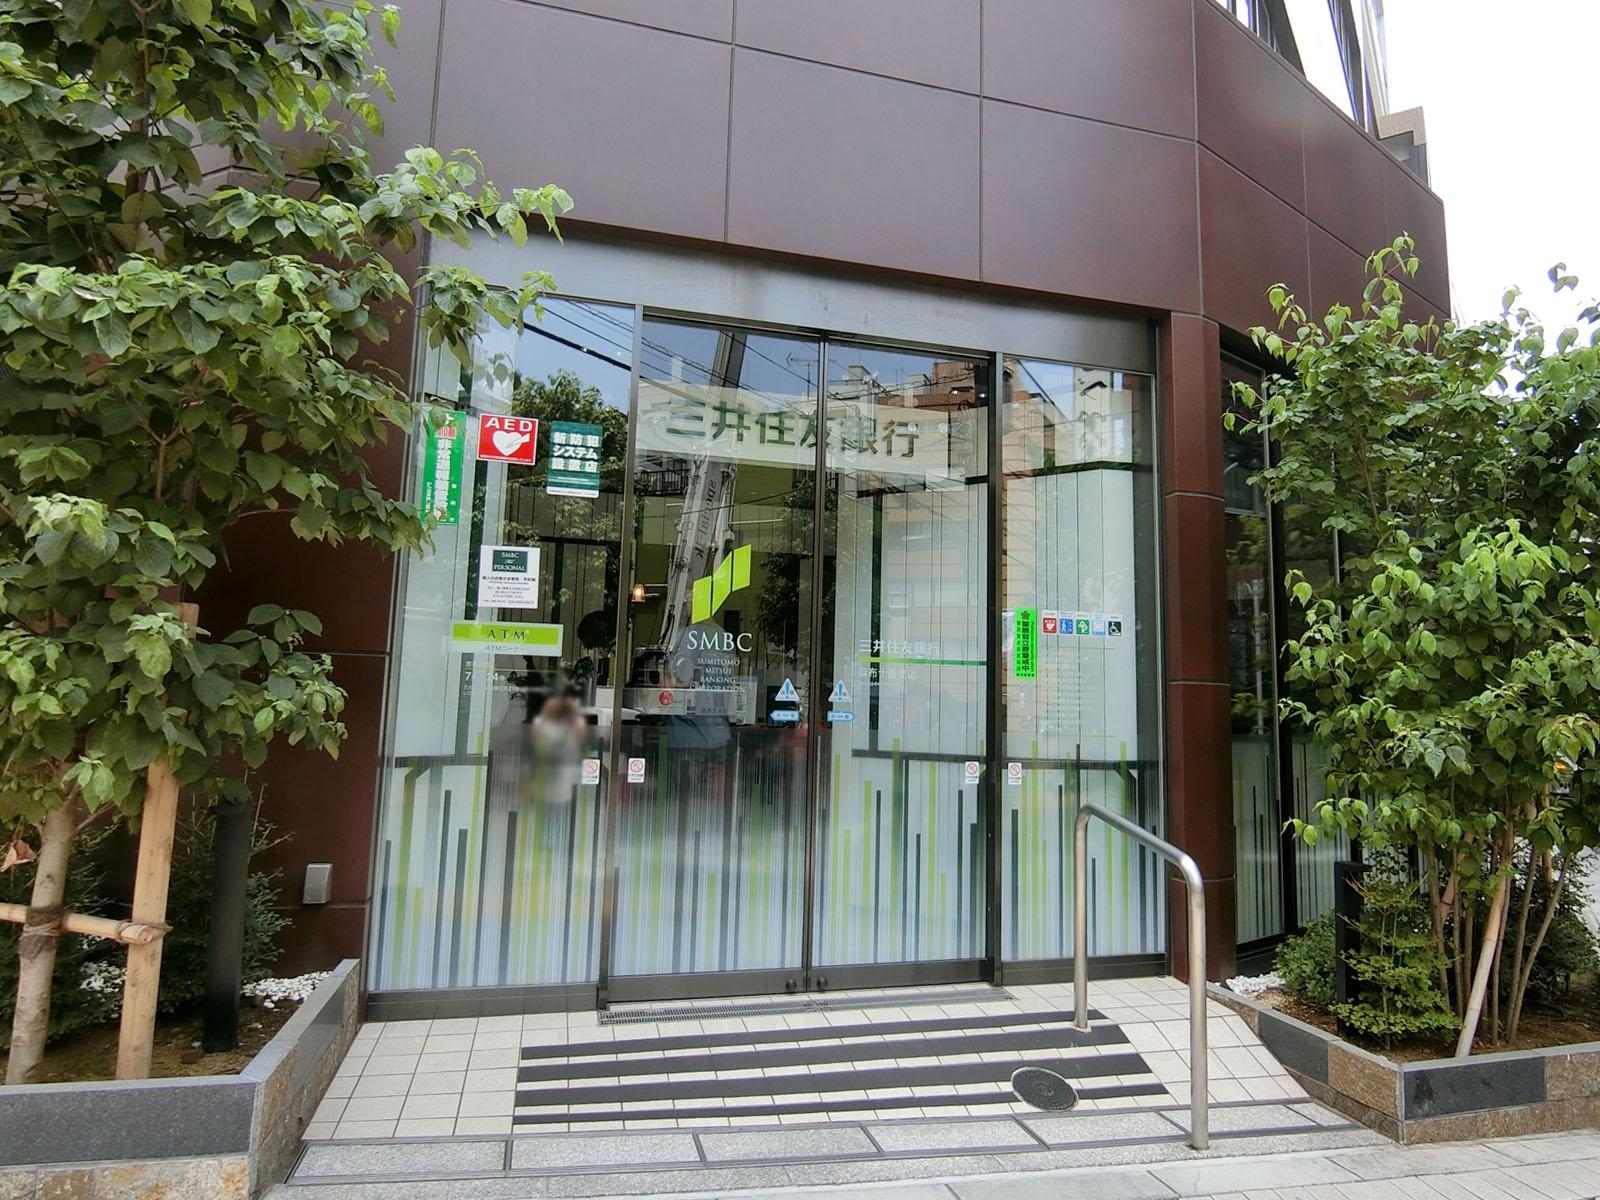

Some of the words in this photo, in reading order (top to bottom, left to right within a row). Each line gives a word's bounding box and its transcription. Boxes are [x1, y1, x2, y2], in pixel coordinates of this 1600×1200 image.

[485, 417, 533, 432] AED
[665, 398, 920, 458] 三井住友銀行
[553, 431, 600, 448] 新防犯
[552, 444, 599, 460] システム
[487, 628, 526, 641] ATM
[687, 630, 753, 652] SMBC
[859, 639, 941, 656] 三井住友銀行
[697, 658, 741, 667] SUMITOMO
[705, 667, 732, 675] MITSUI
[700, 675, 737, 684] BANKING
